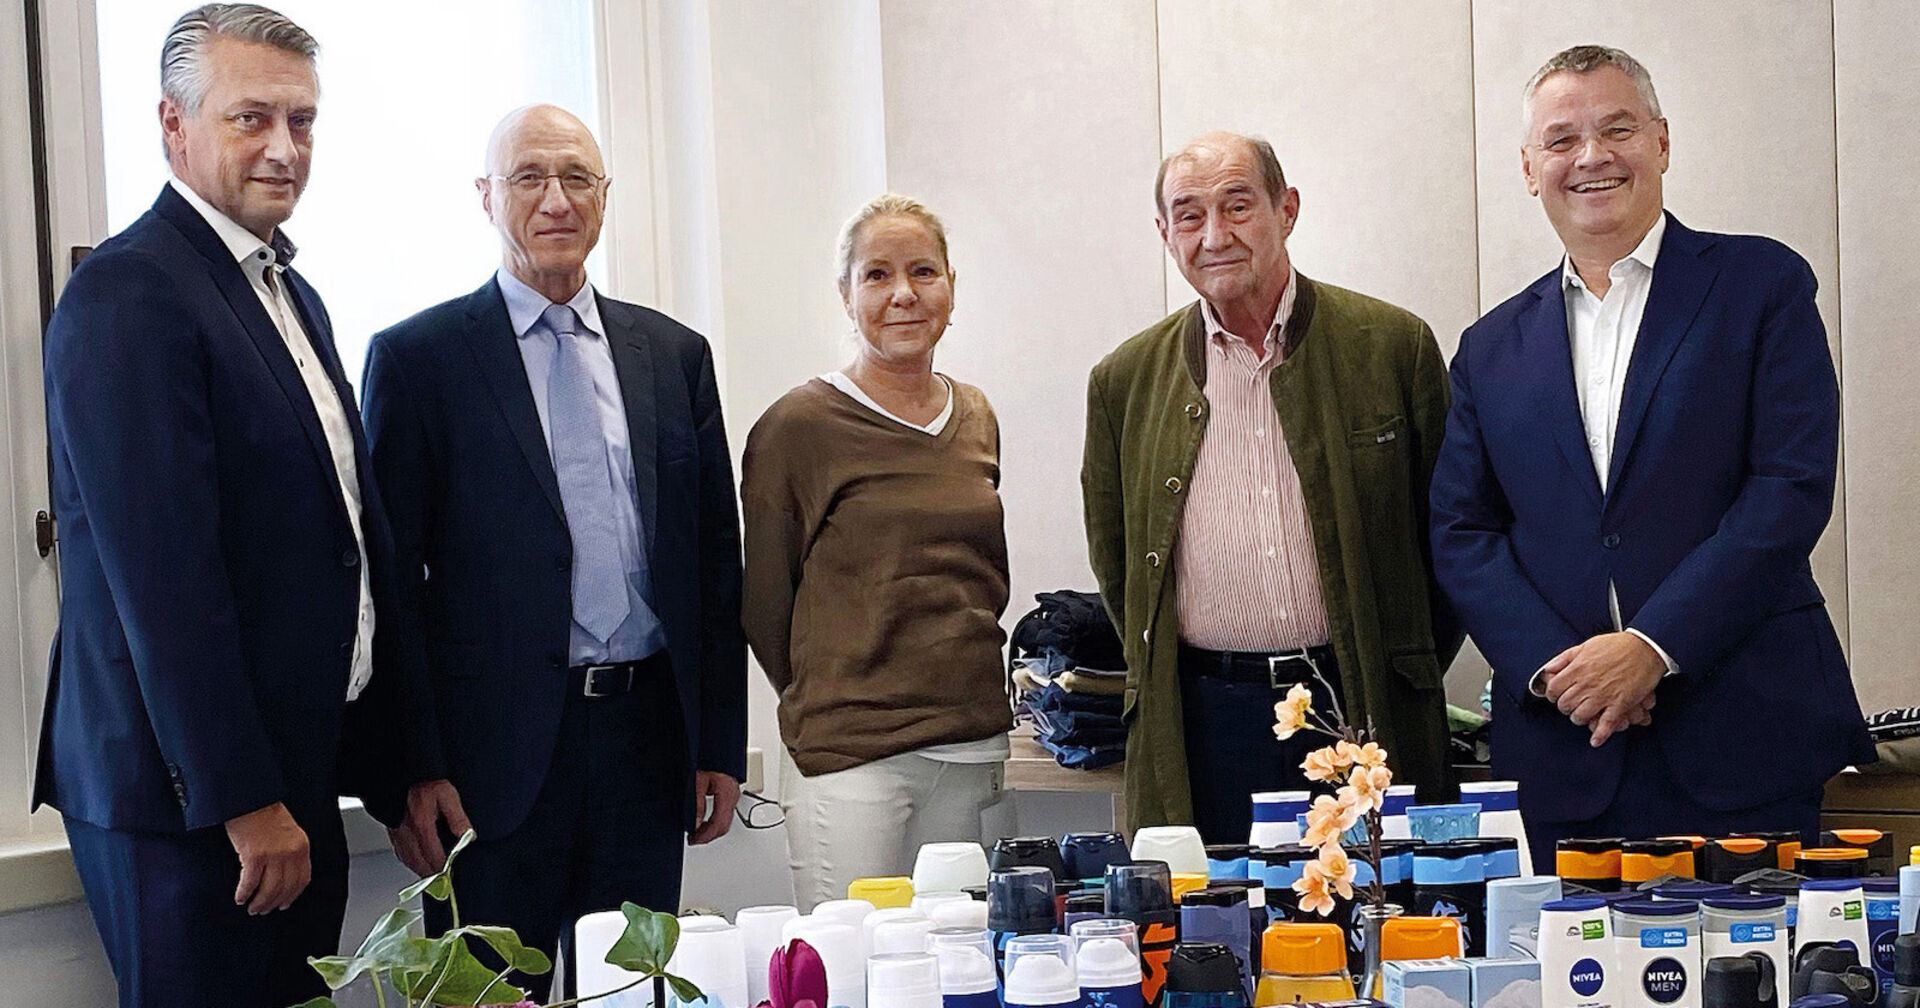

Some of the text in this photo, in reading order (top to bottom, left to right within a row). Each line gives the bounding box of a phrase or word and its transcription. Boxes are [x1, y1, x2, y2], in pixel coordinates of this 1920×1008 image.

[1878, 944, 1896, 953] NIV
[1572, 973, 1602, 983] NIVEA
[1648, 971, 1683, 981] NIVEA
[1651, 982, 1680, 992] MEN
